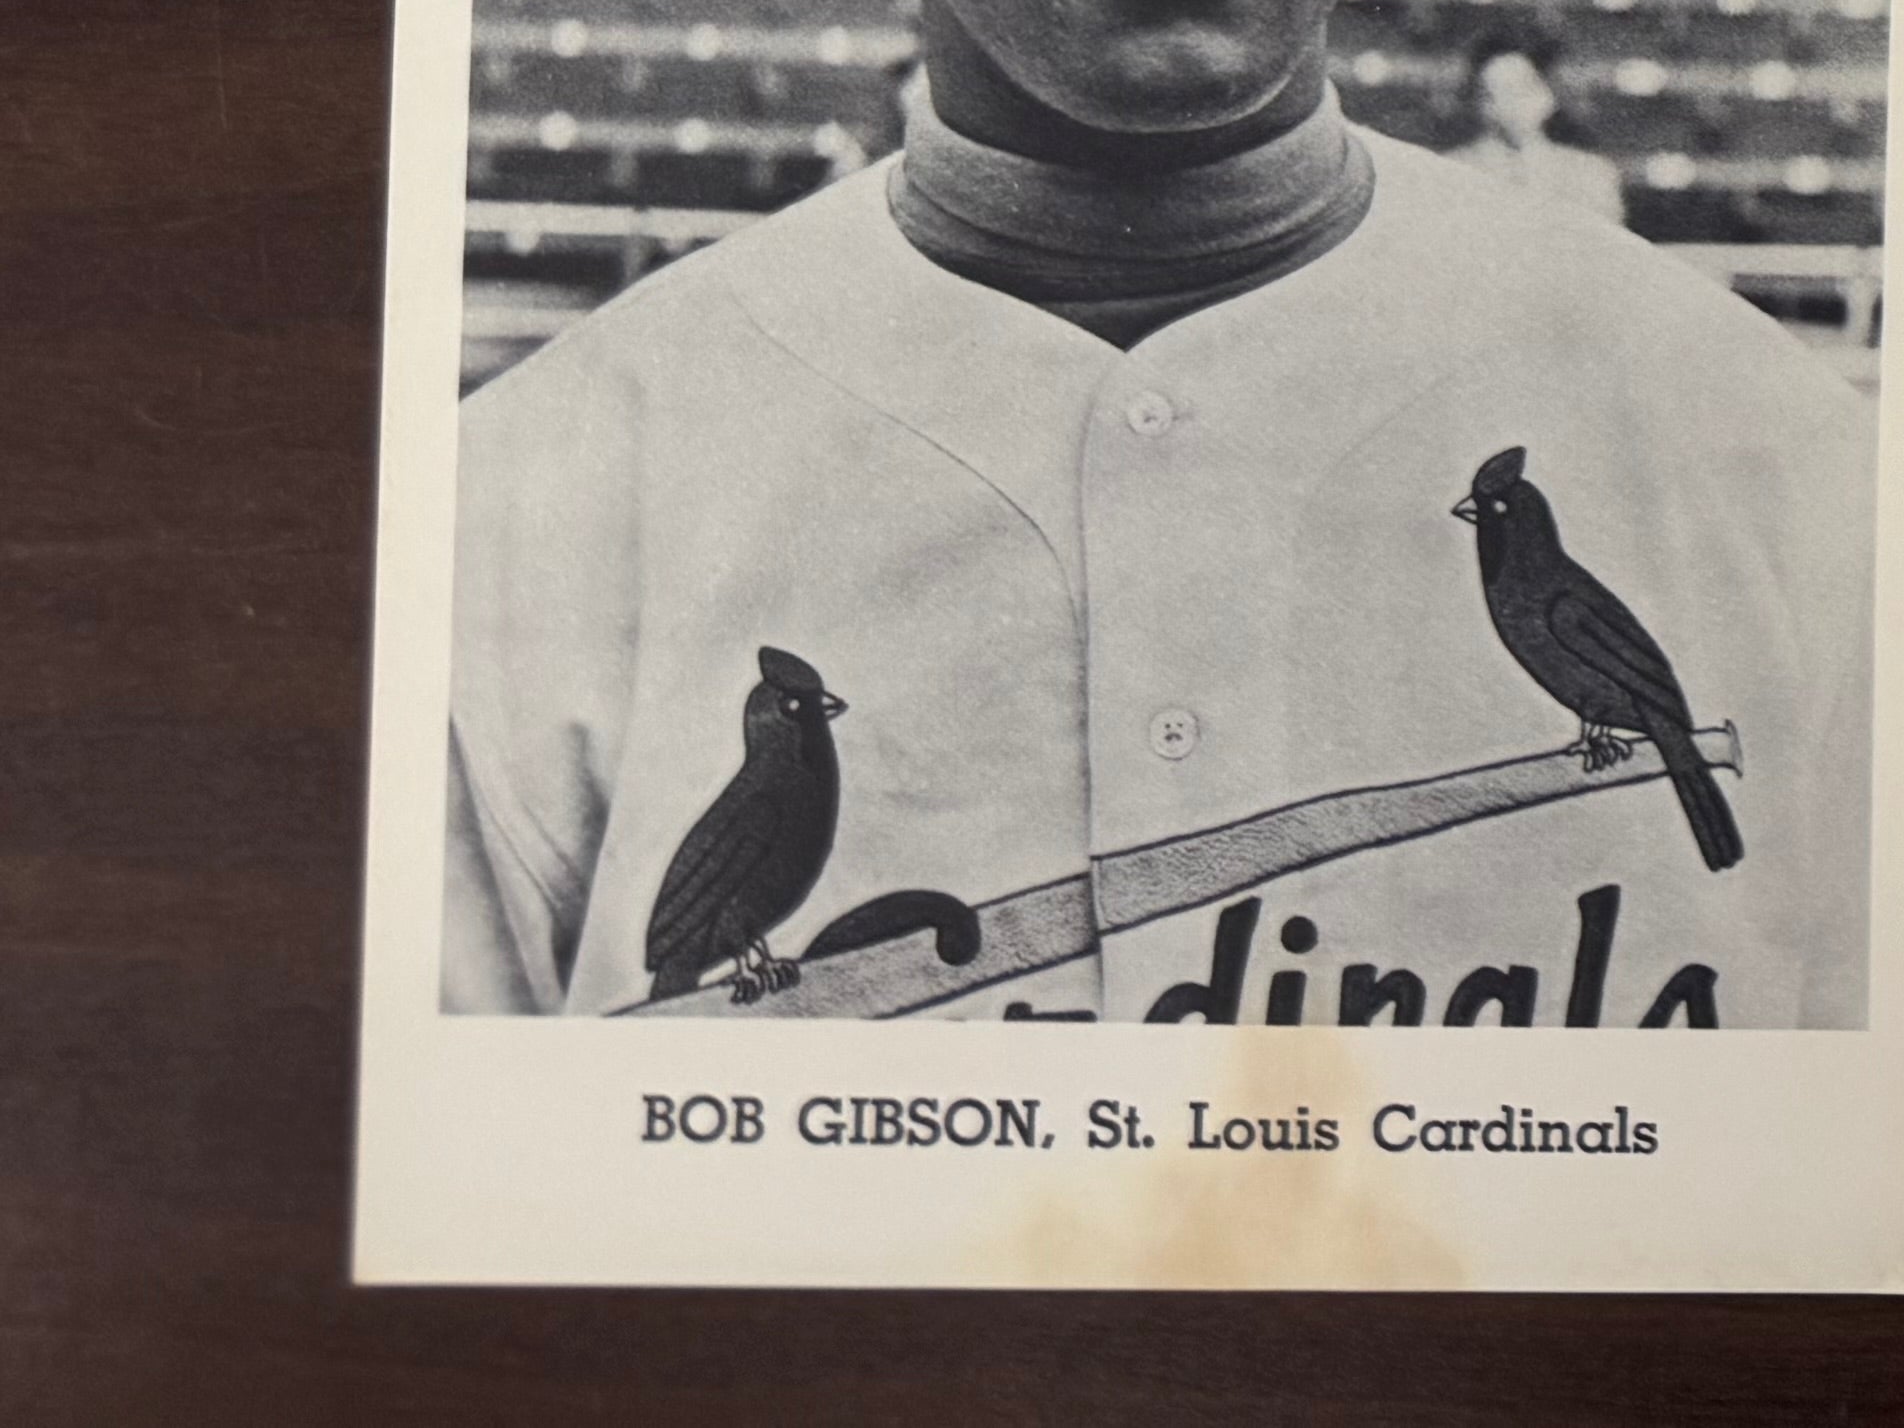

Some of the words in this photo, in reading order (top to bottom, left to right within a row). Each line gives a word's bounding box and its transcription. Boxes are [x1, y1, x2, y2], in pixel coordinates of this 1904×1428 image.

[639, 1093, 766, 1145] BOB
[796, 1095, 1056, 1150] GIBSON,
[1086, 1098, 1156, 1150] St.
[1186, 1100, 1341, 1152] Louis
[1371, 1102, 1659, 1156] Cardinals
